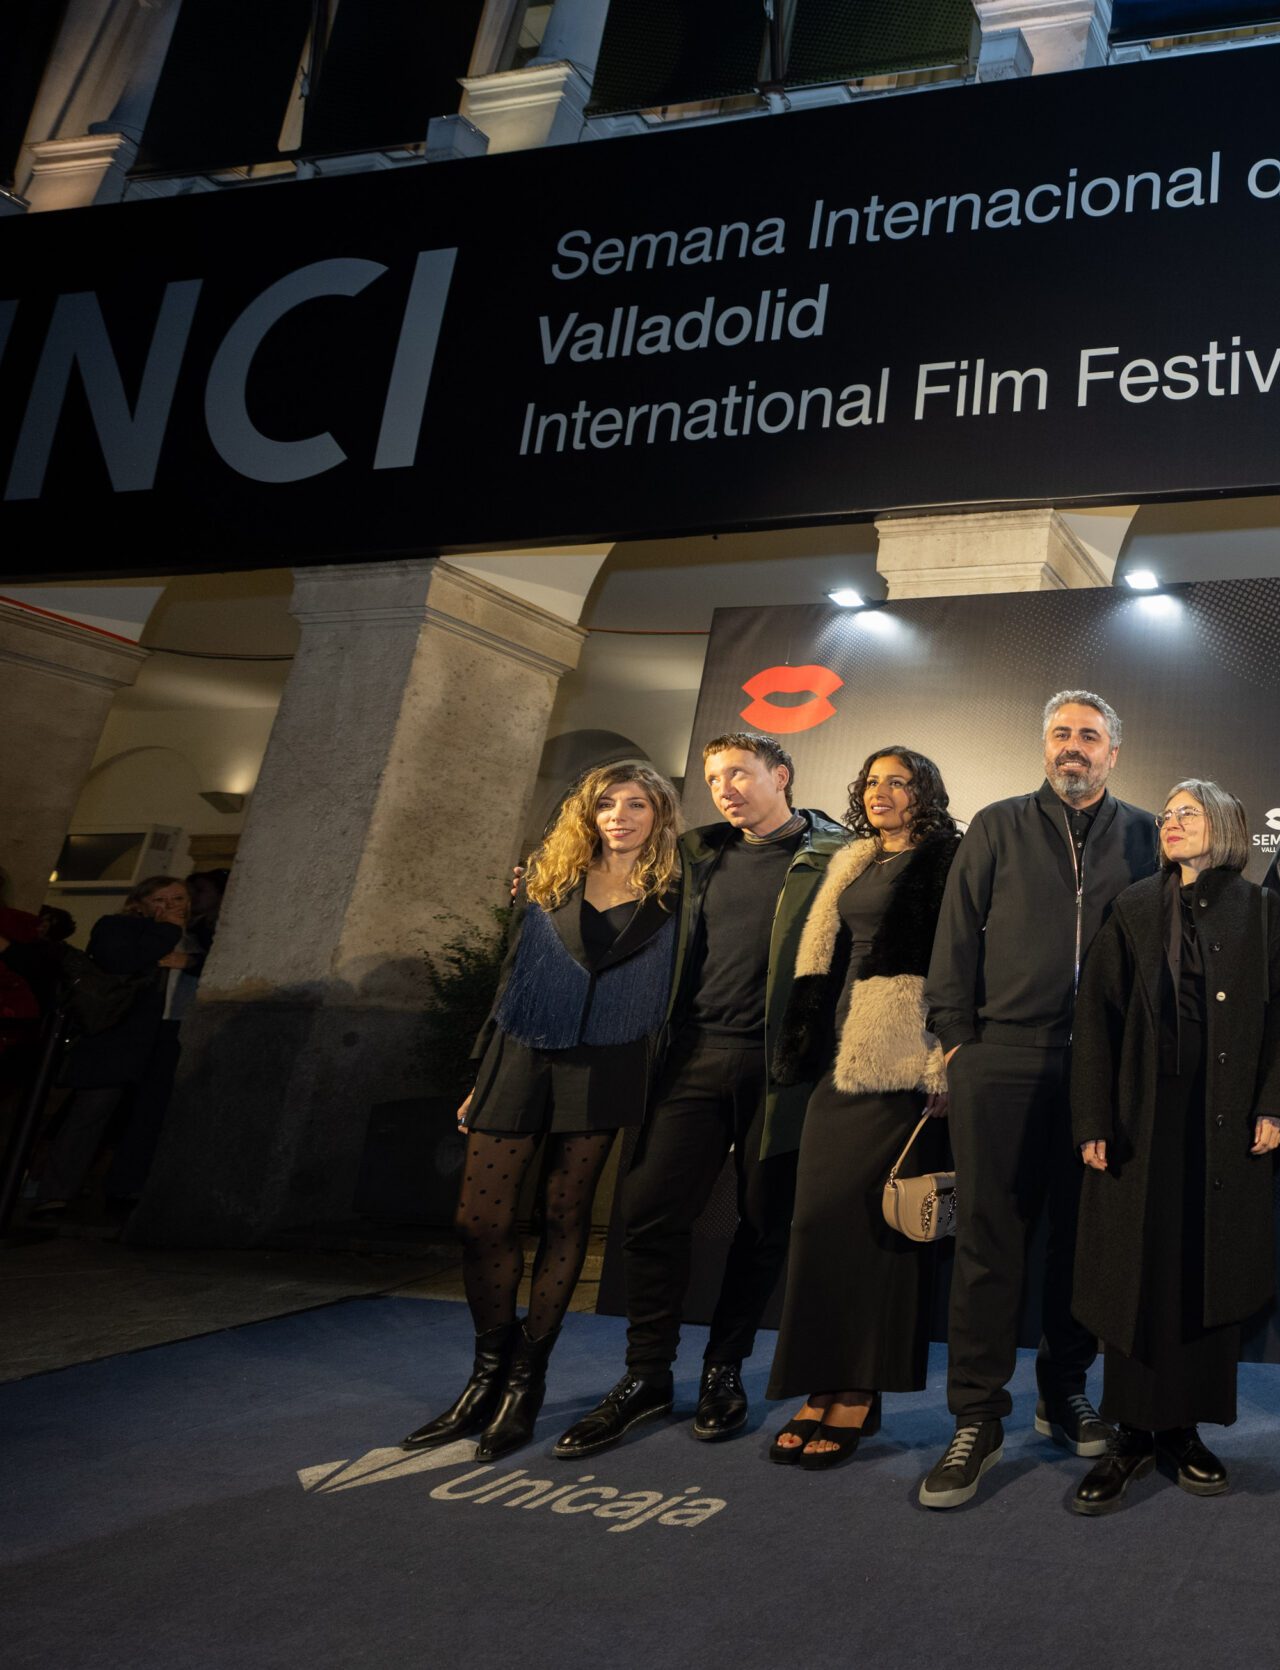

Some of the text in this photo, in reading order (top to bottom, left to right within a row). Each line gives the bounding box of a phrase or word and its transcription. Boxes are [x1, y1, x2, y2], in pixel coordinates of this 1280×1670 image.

[551, 217, 786, 280] Semana
[808, 150, 1221, 250] Internacional
[539, 283, 830, 365] Valladolid
[519, 367, 890, 456] International
[914, 357, 1049, 421] Film
[429, 1465, 728, 1533] Unicaja
